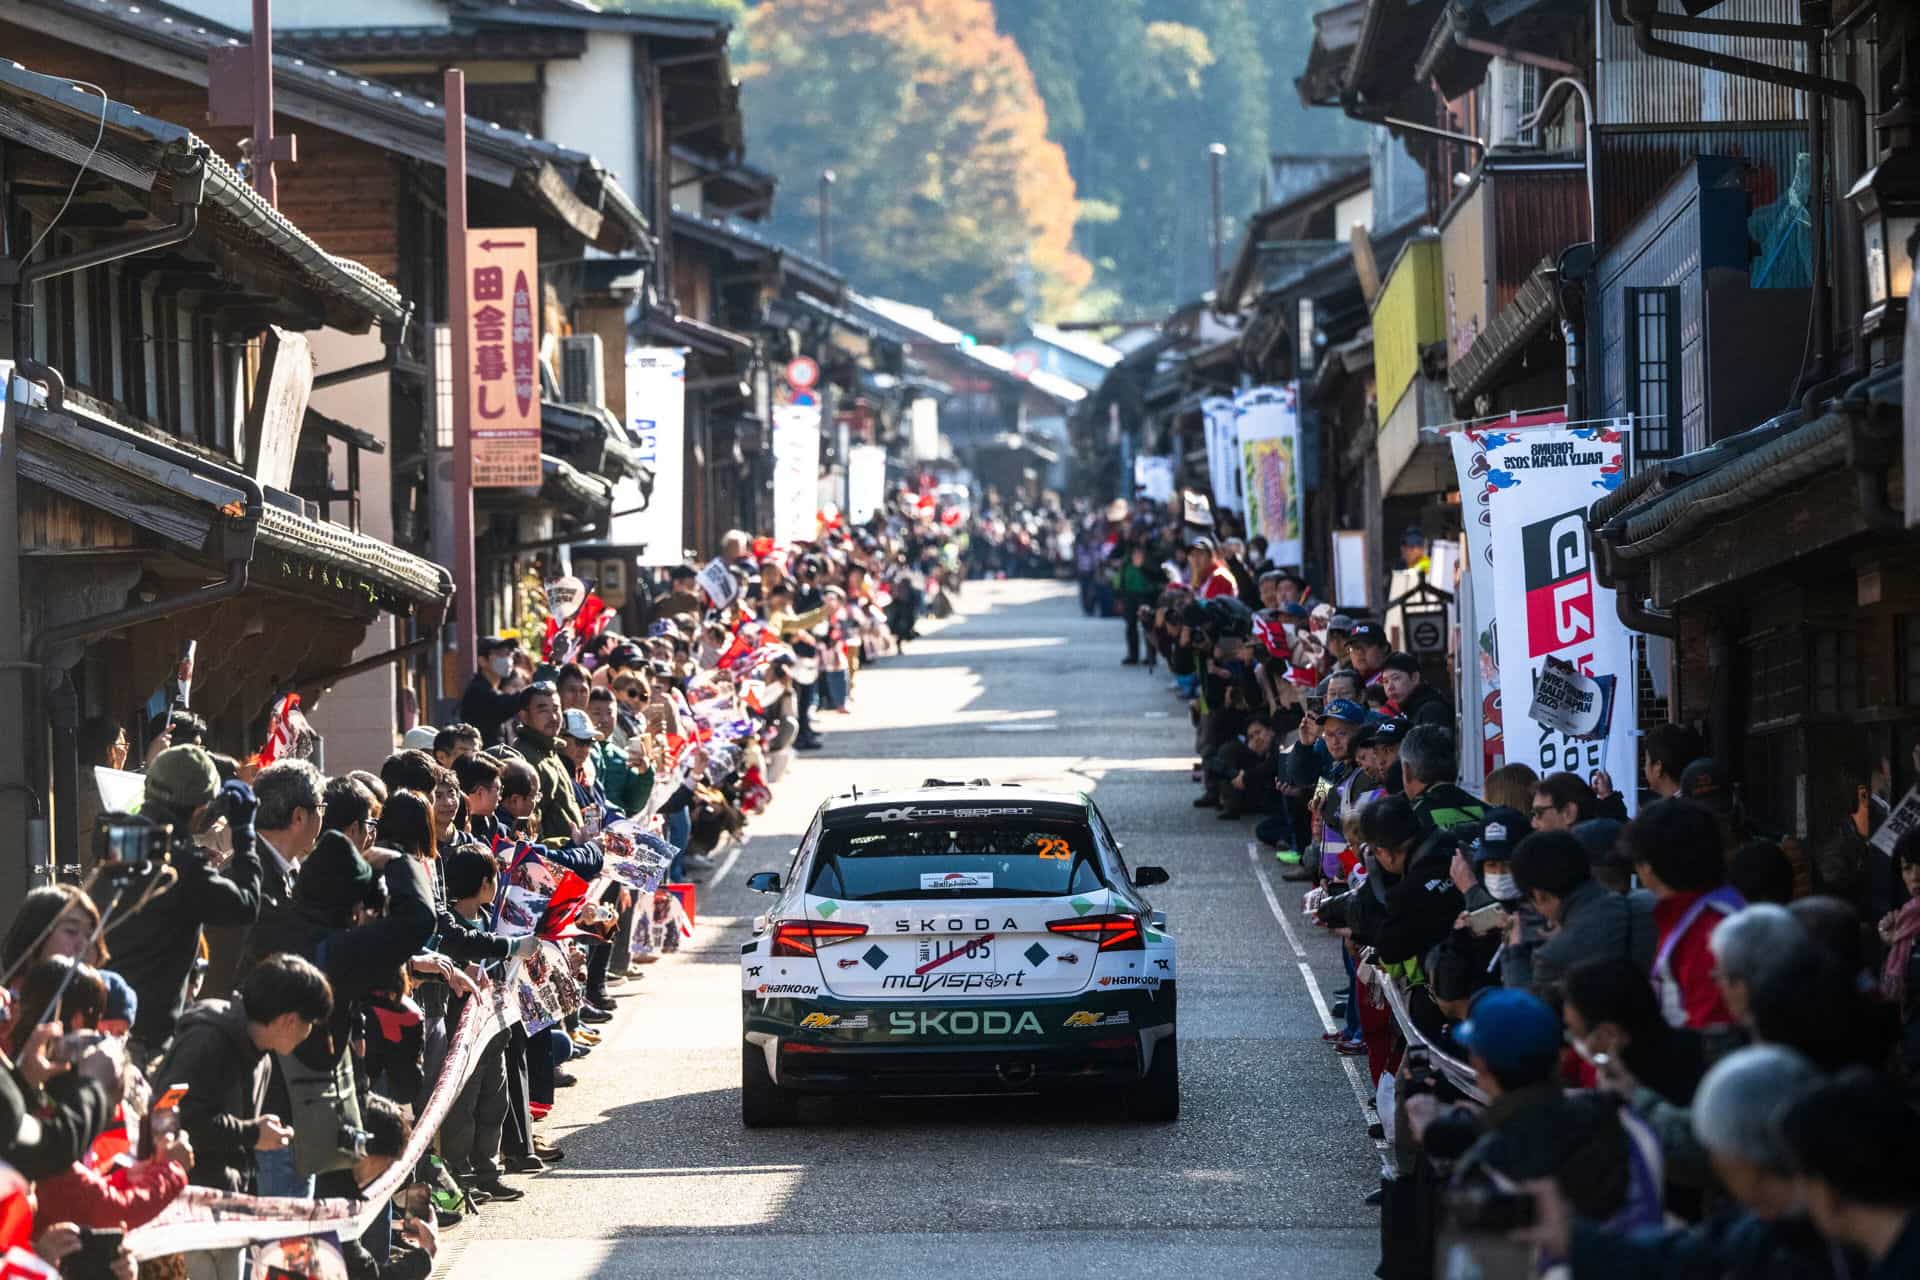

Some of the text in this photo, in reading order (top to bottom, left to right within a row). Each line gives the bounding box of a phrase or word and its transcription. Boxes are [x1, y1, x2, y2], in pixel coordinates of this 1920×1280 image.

[473, 266, 507, 420] 田舎暮し
[1037, 839, 1071, 861] 23
[919, 940, 930, 962] 三河
[882, 969, 1027, 993] movisport
